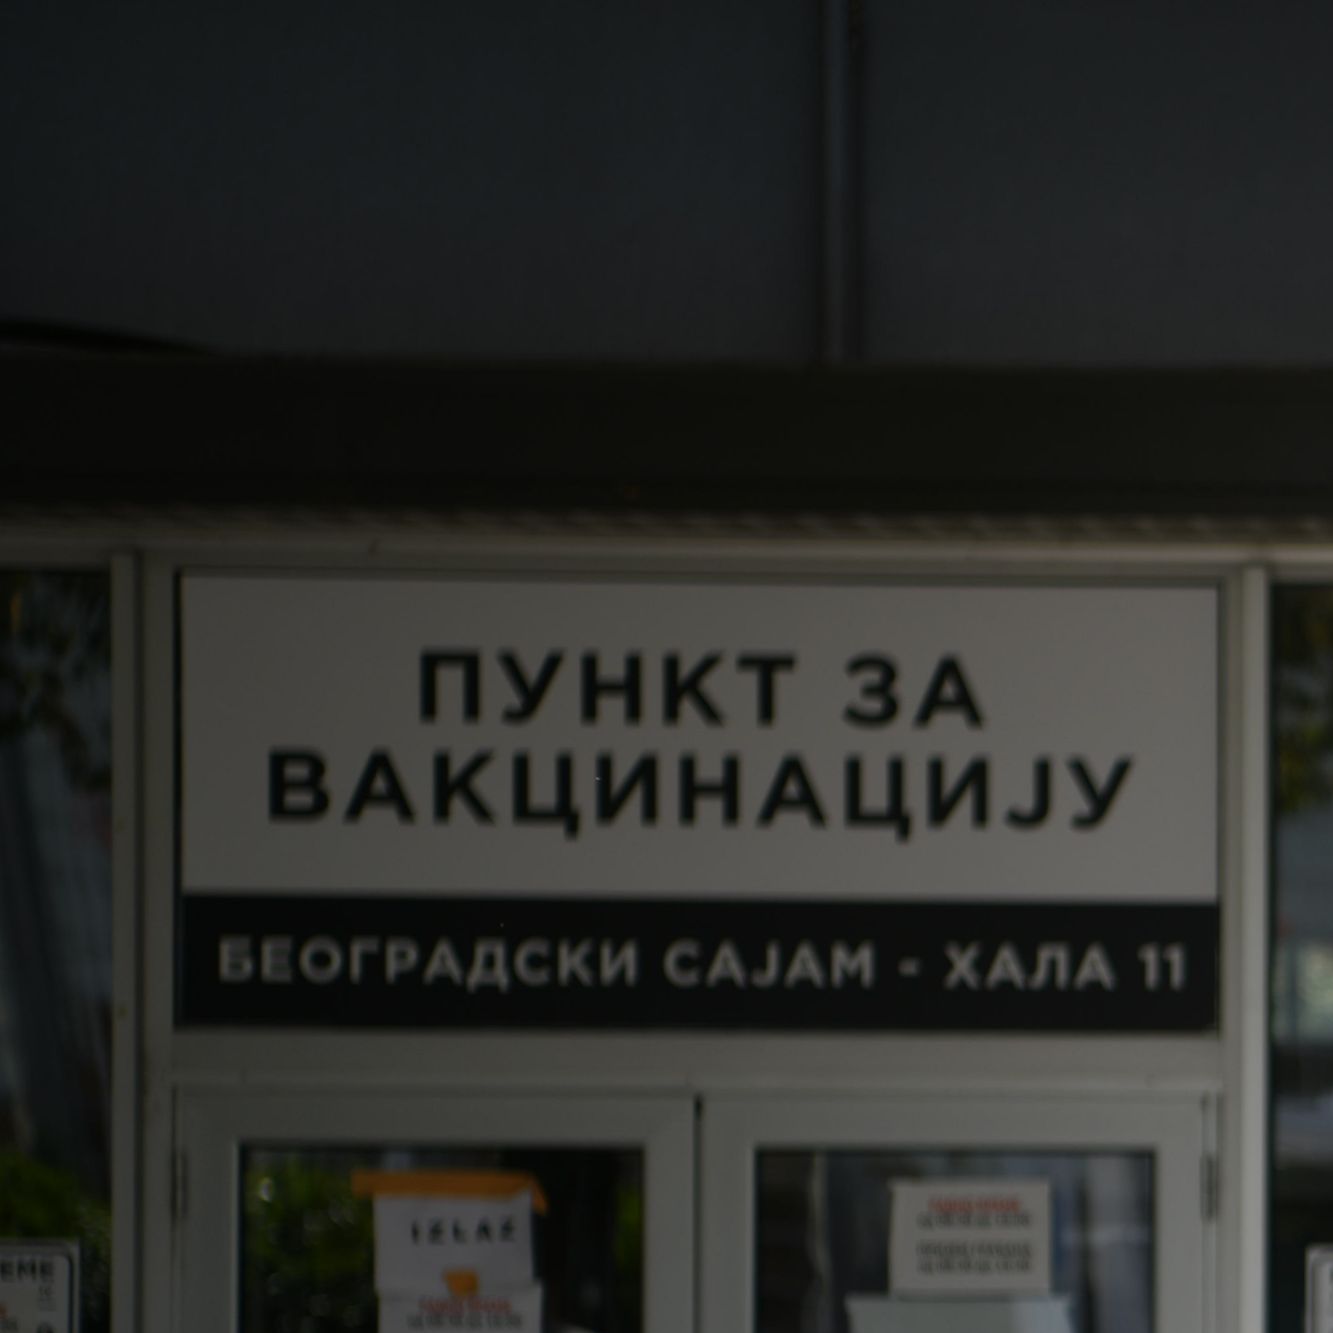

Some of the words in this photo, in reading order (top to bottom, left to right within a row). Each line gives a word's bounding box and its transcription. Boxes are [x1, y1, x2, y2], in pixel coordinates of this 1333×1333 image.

[420, 650, 797, 728] ПУНКТ
[843, 654, 985, 729] ЗА
[267, 749, 1134, 842] ВАКЦИНАЦИЈУ
[218, 937, 639, 992] БЕОГРАДСКИ
[662, 940, 875, 988] САЈАМ
[945, 943, 1116, 990] ХАЛА
[1138, 945, 1187, 990] 11
[409, 1215, 518, 1246] IZLAZ
